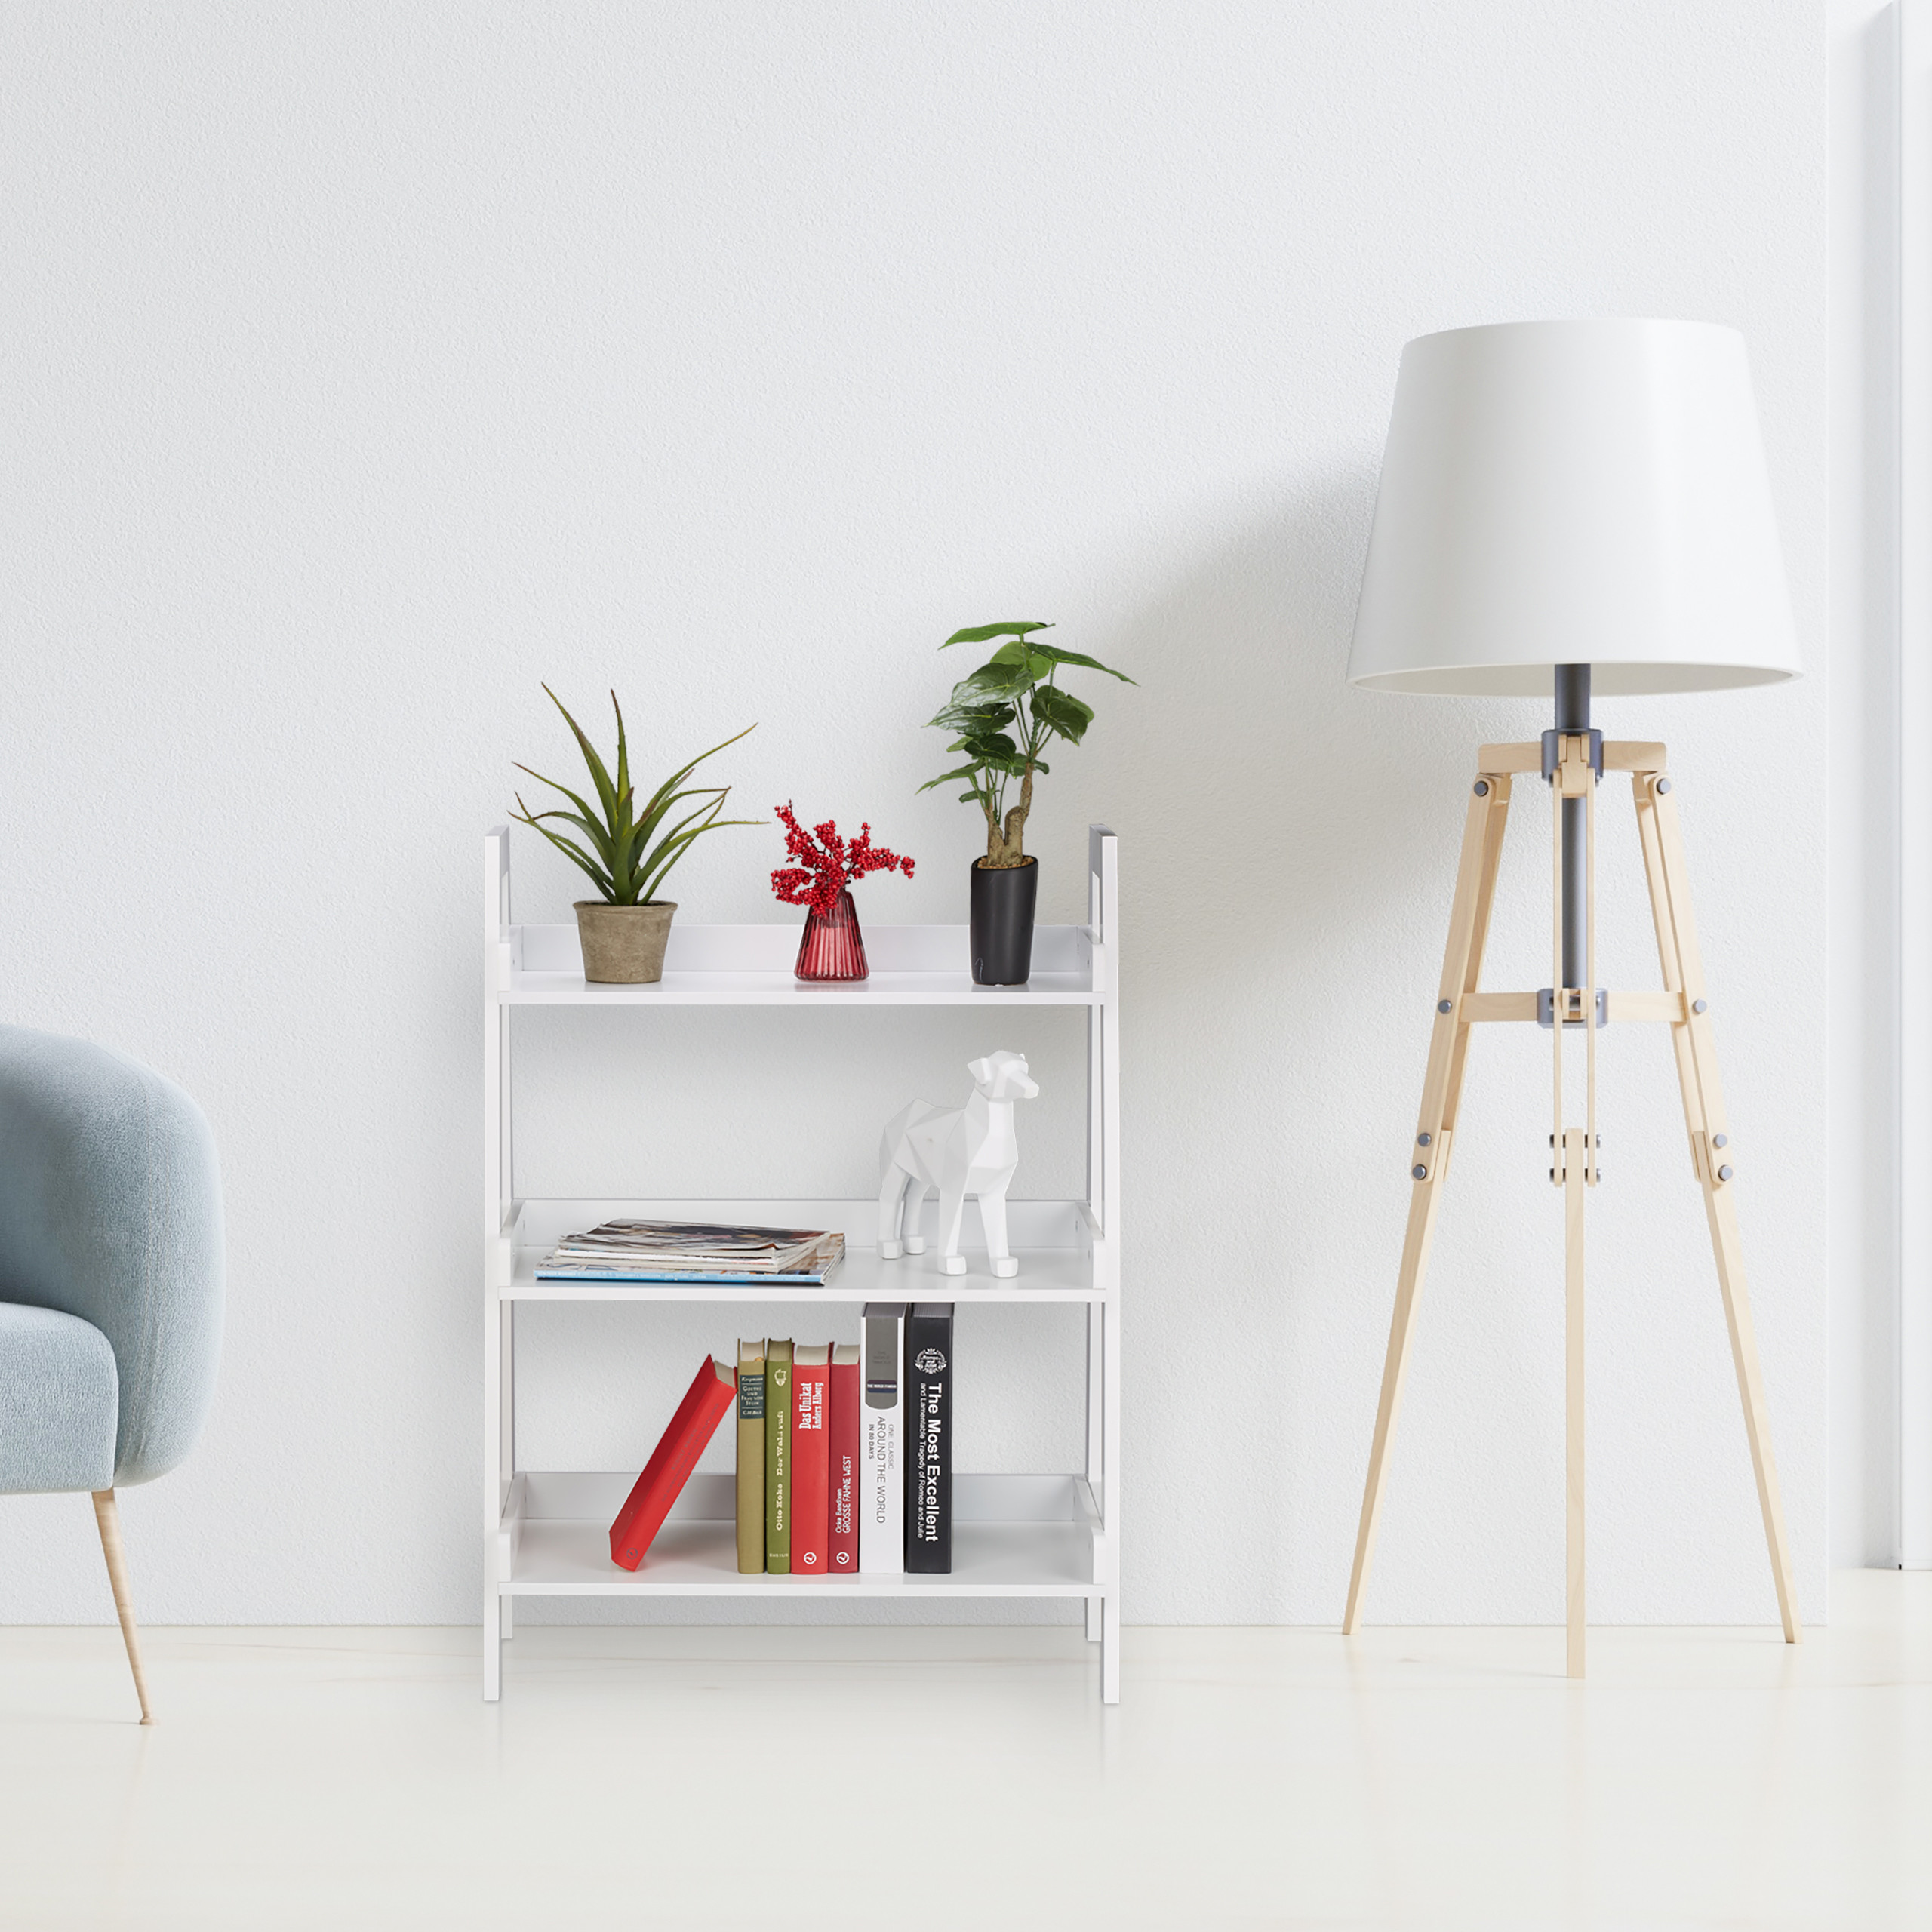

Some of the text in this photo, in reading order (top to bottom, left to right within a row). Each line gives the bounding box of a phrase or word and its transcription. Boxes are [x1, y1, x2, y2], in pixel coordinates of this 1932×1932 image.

[799, 1383, 812, 1429] Das Unikat
[813, 1382, 823, 1429] Anders Alborg
[928, 1383, 942, 1414] The
[918, 1441, 926, 1469] Tragedy
[927, 1419, 940, 1460] Most
[843, 1455, 851, 1476] WEST
[876, 1416, 886, 1524] AROUND THE WORLD
[843, 1478, 851, 1501] FAHNE
[925, 1465, 940, 1542] Excellent
